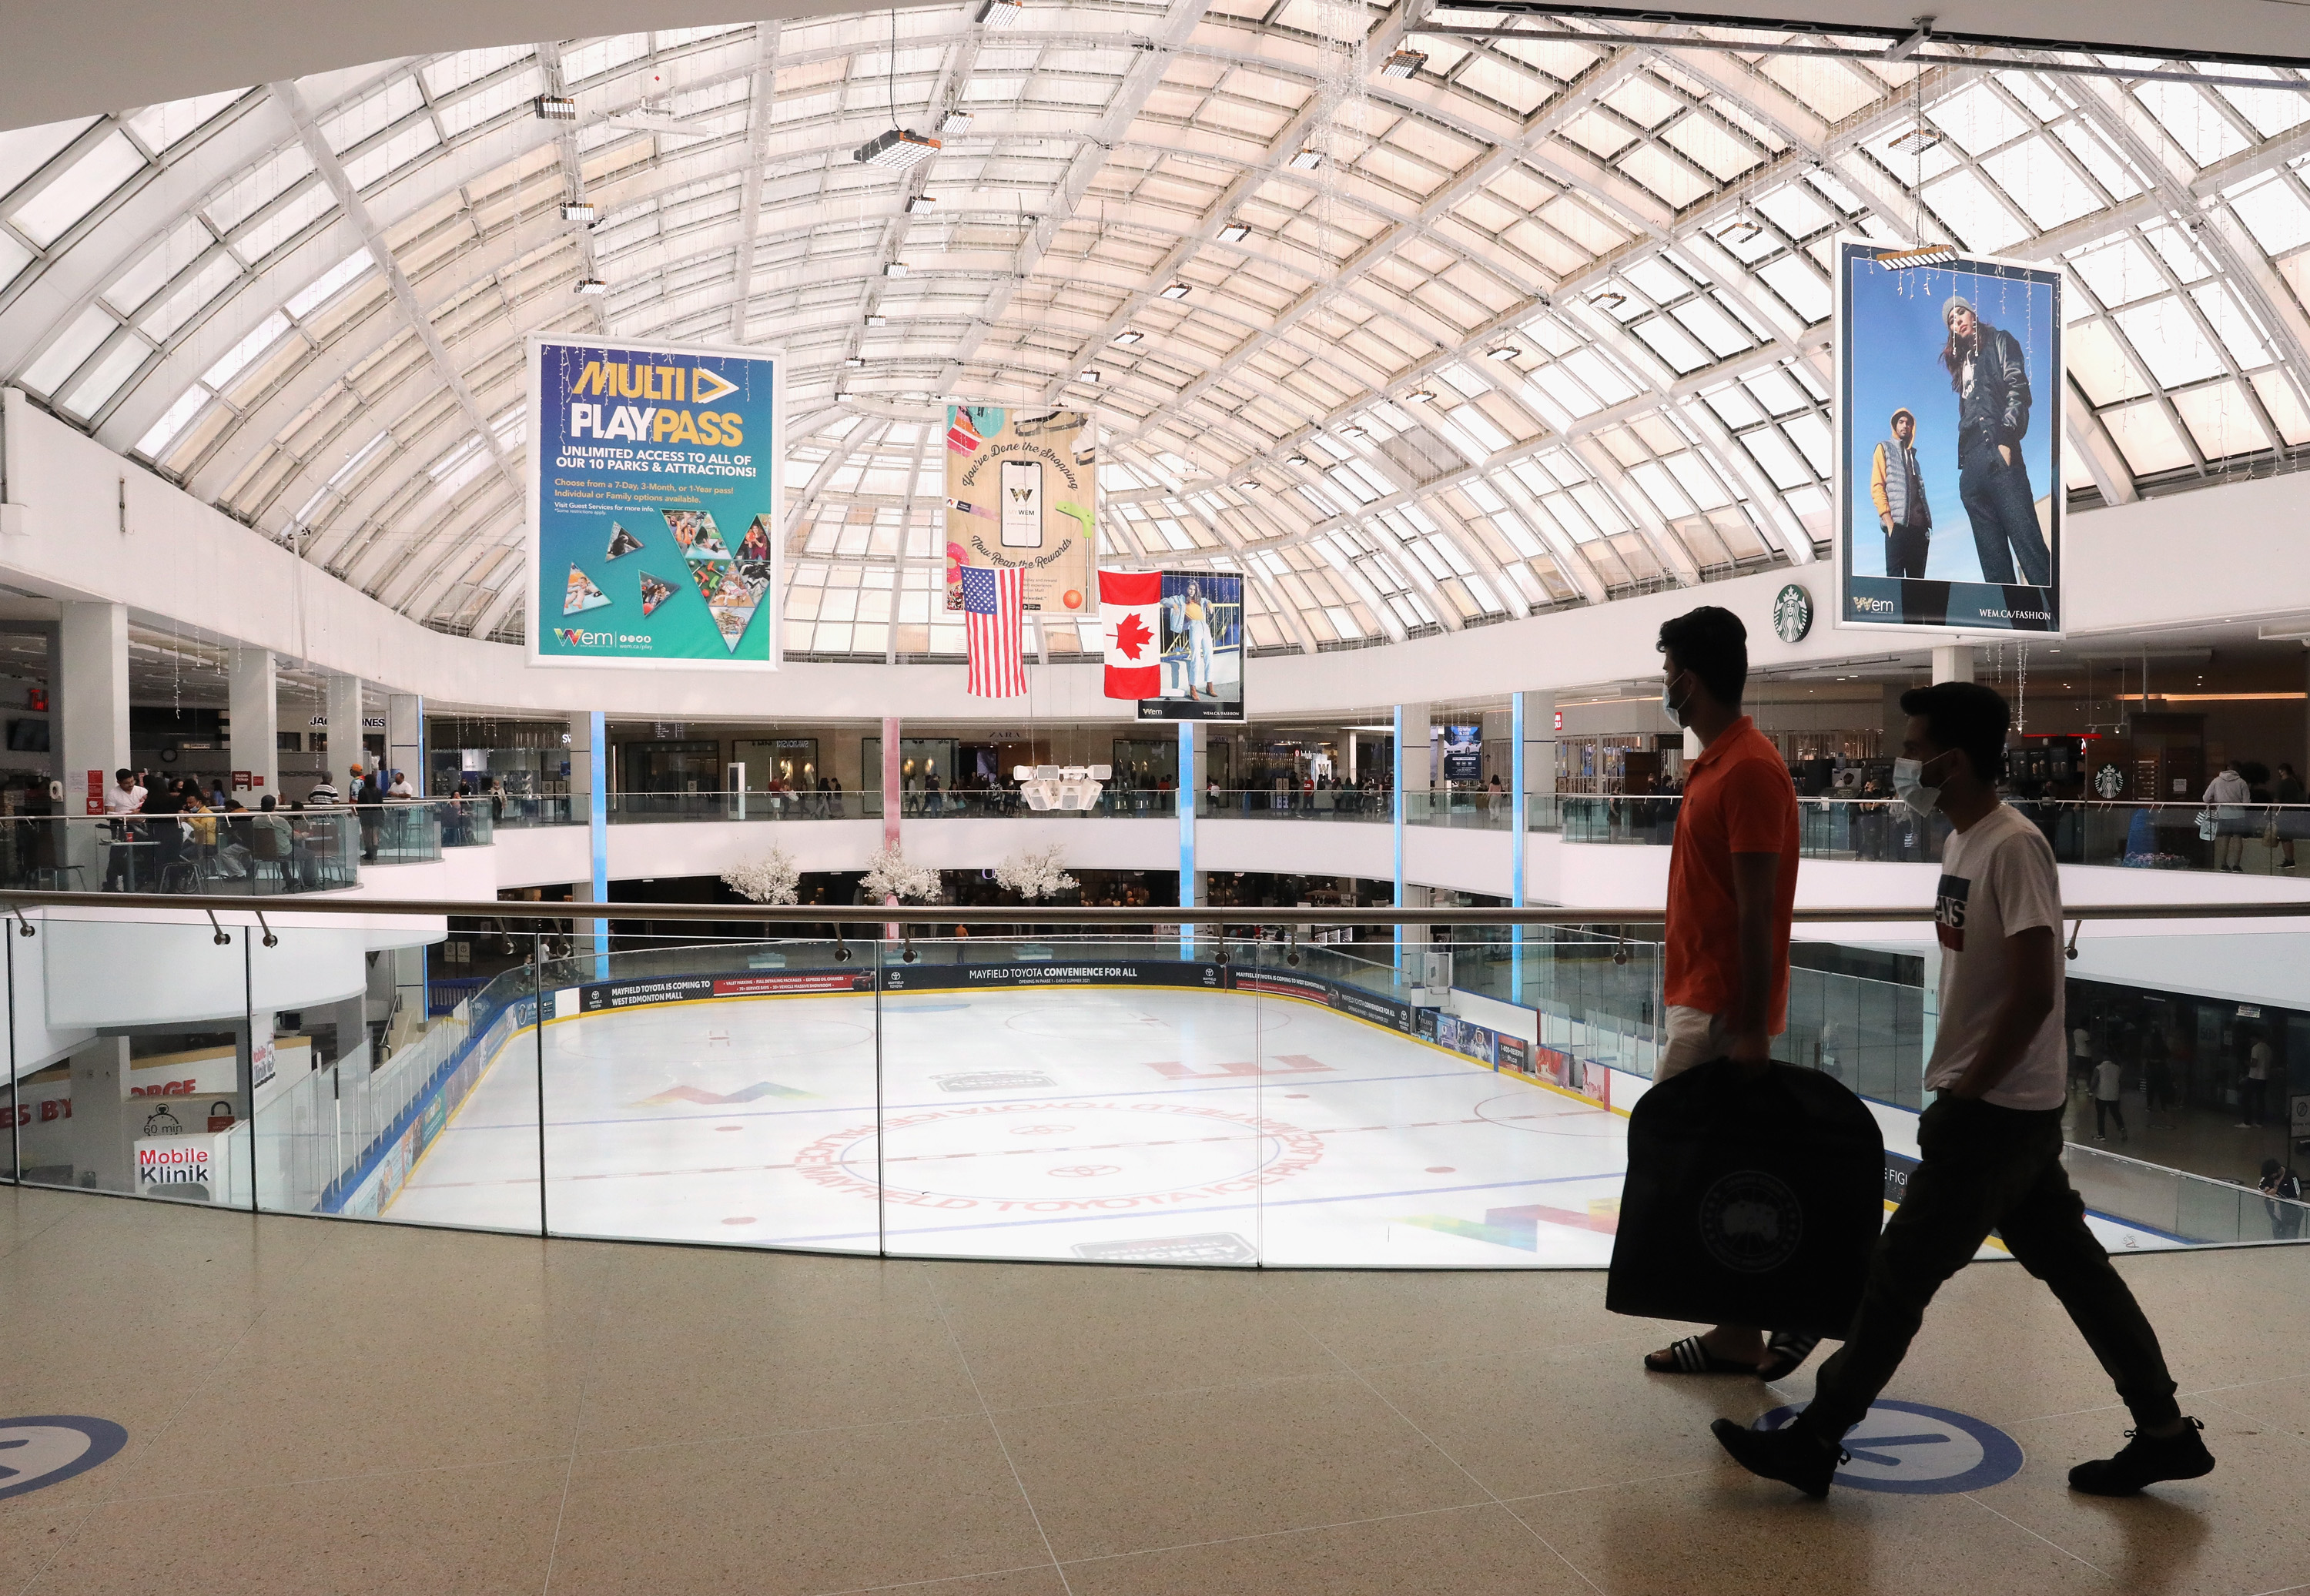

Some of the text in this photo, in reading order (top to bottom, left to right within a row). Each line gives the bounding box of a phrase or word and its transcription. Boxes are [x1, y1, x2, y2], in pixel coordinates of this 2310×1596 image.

[571, 360, 685, 401] MULTI
[571, 402, 744, 447] PLAYPASS
[562, 446, 752, 466] UNLIMITED ACCESS TO ALL OF
[556, 457, 757, 477] OUR 10 PARKS & ATTRACTIONS!
[990, 443, 1021, 458] Done
[1022, 441, 1040, 453] the
[1039, 448, 1079, 491] Shopping
[554, 478, 585, 487] Choose
[587, 480, 606, 488] from
[614, 481, 639, 491] 7-Day,
[641, 483, 676, 493] 3-Month,
[689, 484, 712, 494] 1-Year
[714, 486, 734, 496] pass!
[554, 490, 593, 499] Individual
[606, 491, 632, 503] Family
[634, 493, 662, 504] options
[665, 494, 701, 504] available.
[970, 535, 992, 558] Now
[992, 551, 1017, 569] Reap
[1035, 538, 1072, 569] Rewards
[1979, 608, 2051, 621] WEM.CA/FASHION
[554, 627, 613, 647] Wem
[969, 968, 1138, 979] MAYFIELD TOYOTA CONVENIENCE FOR ALL
[611, 985, 641, 996] MAYFIELD
[641, 983, 665, 992] TOYOTA
[672, 981, 700, 990] COMING
[611, 992, 683, 1006] WEST EDMONTON MALL
[144, 1123, 182, 1135] 60 min
[140, 1147, 208, 1165] Mobile
[140, 1166, 209, 1184] Klinik
[1890, 1169, 1908, 1186] FIG
[992, 1192, 1210, 1212] TOYOTA
